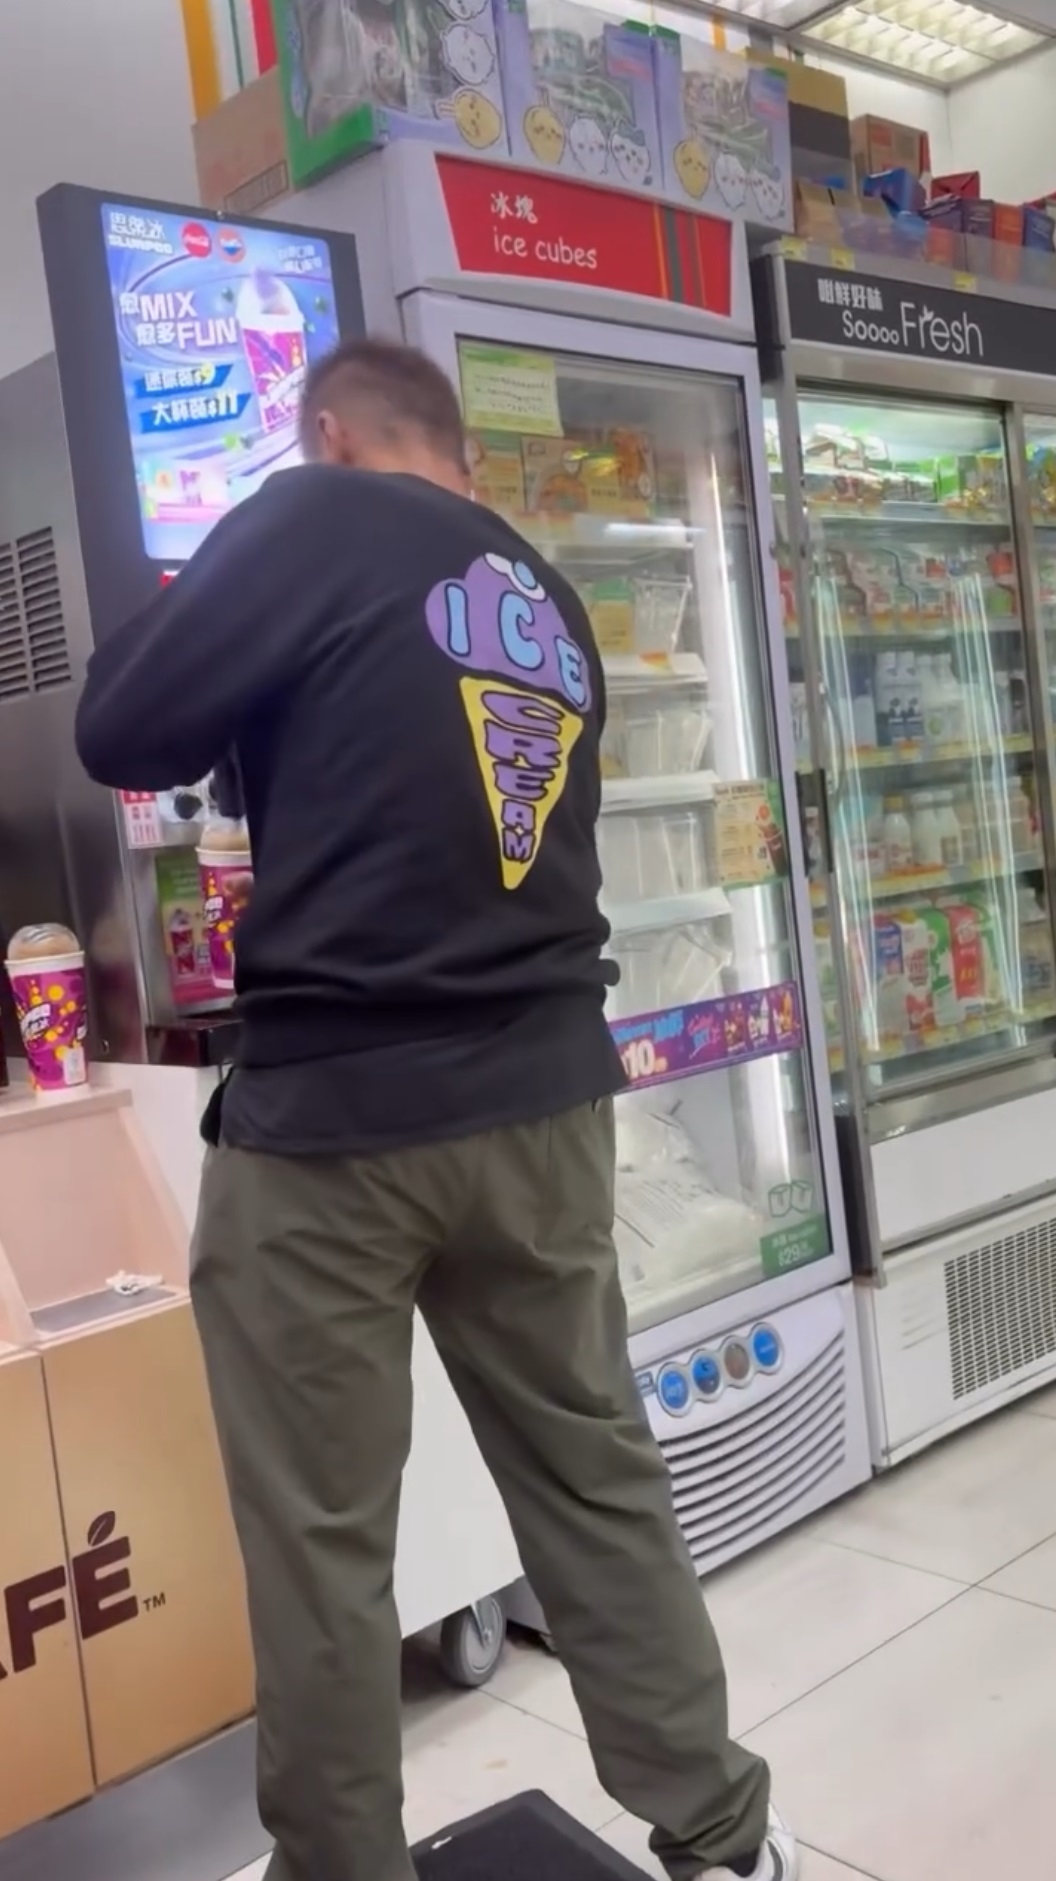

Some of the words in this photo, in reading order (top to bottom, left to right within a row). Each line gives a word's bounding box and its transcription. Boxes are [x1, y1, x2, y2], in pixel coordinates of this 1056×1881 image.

[490, 191, 538, 224] 冰塊
[493, 226, 528, 257] ice
[535, 237, 597, 269] cubes
[444, 582, 588, 708] ICE
[481, 690, 565, 864] CREAM
[0, 1510, 139, 1681] FÉ
